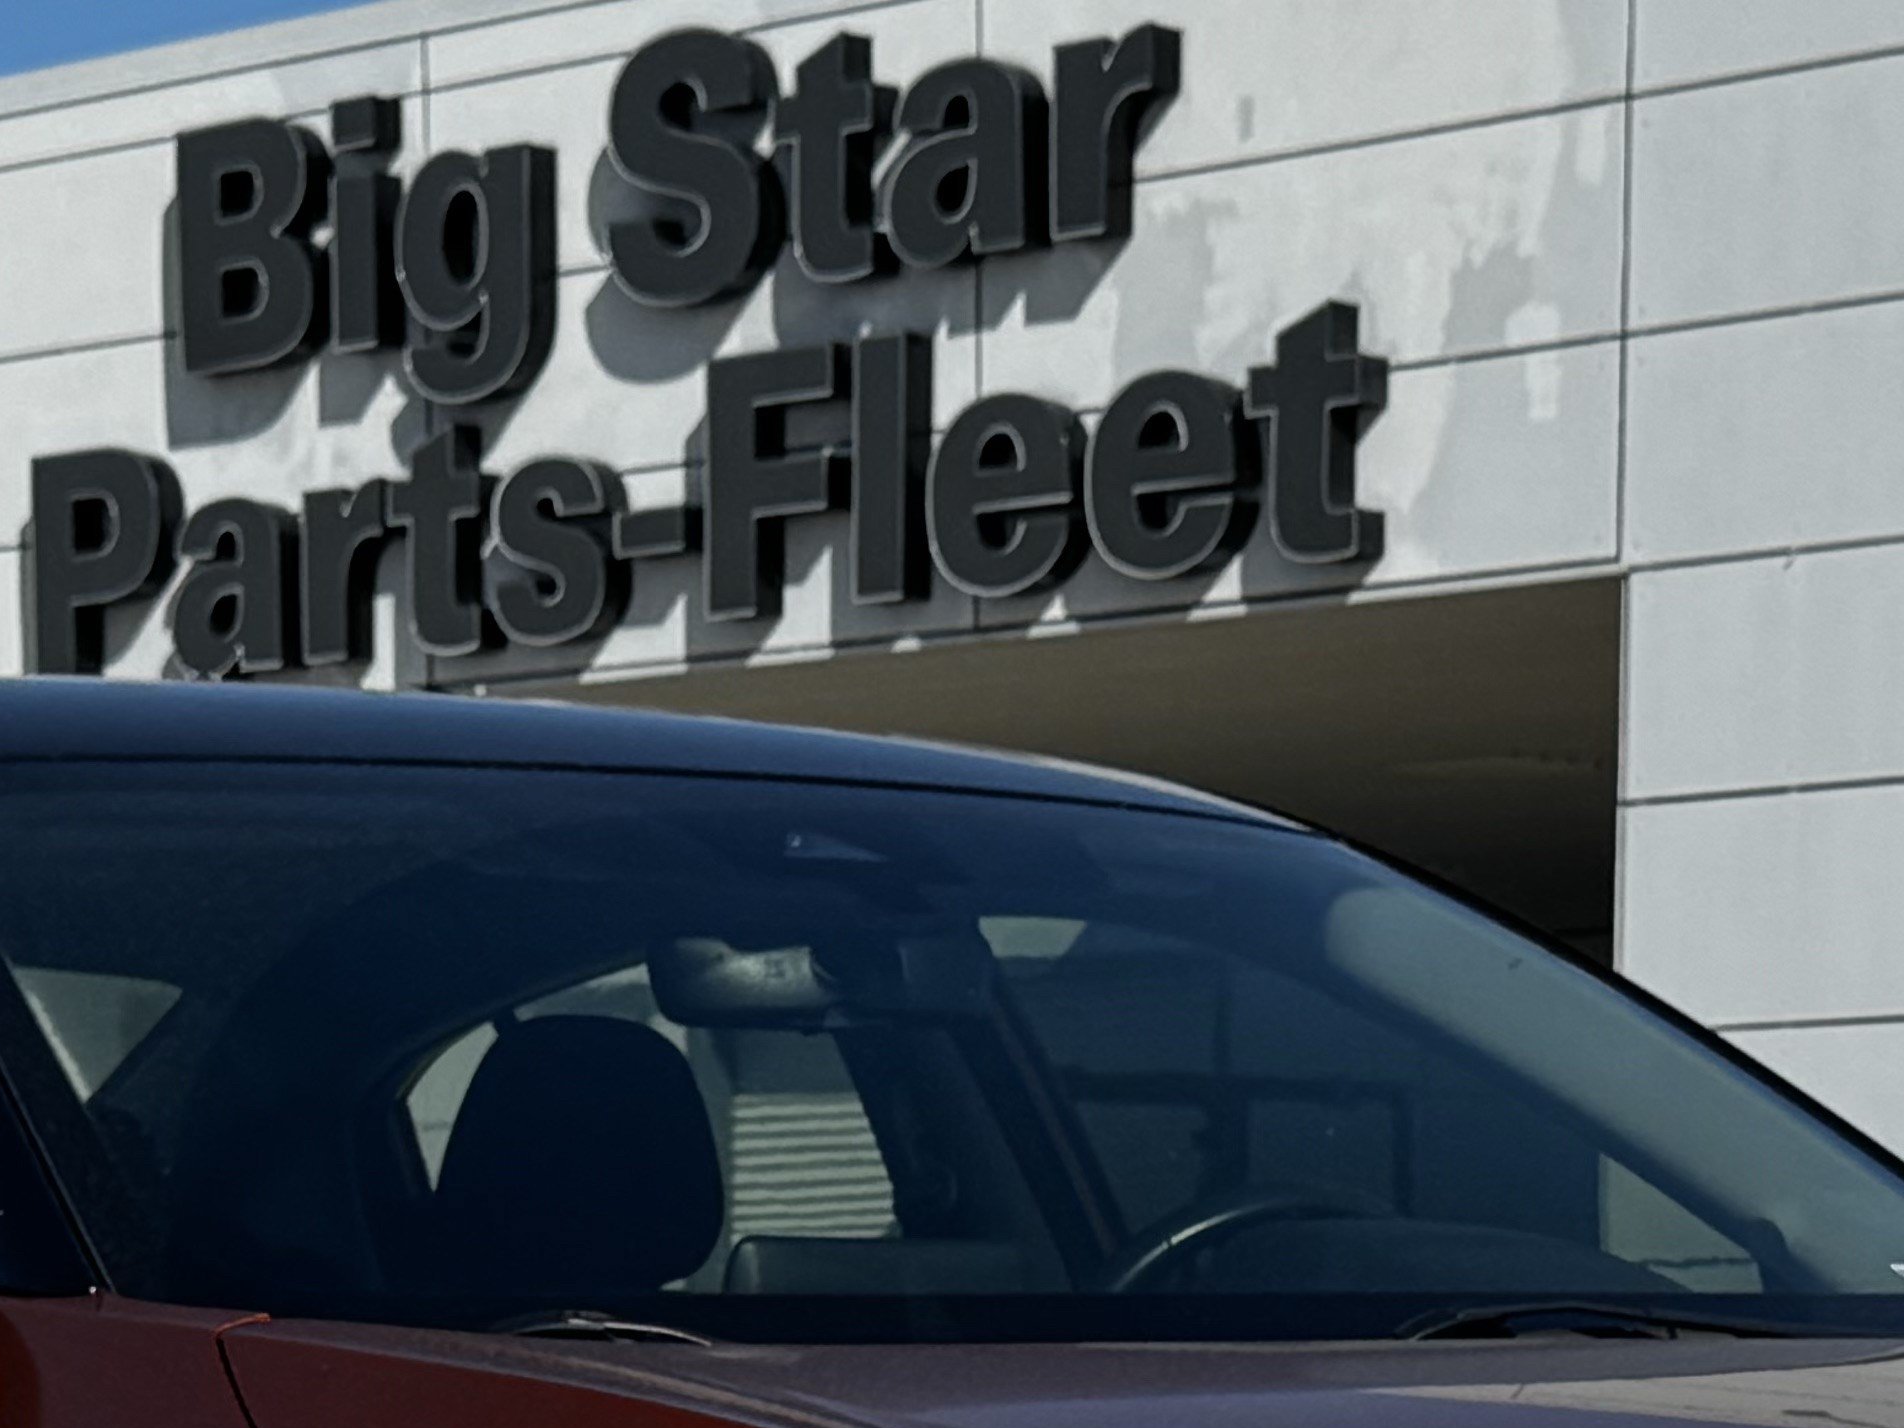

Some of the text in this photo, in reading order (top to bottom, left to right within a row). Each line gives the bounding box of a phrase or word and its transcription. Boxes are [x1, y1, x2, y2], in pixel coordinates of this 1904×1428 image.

[174, 23, 1183, 402] Big Star
[31, 300, 1390, 677] Parts-Fleet
